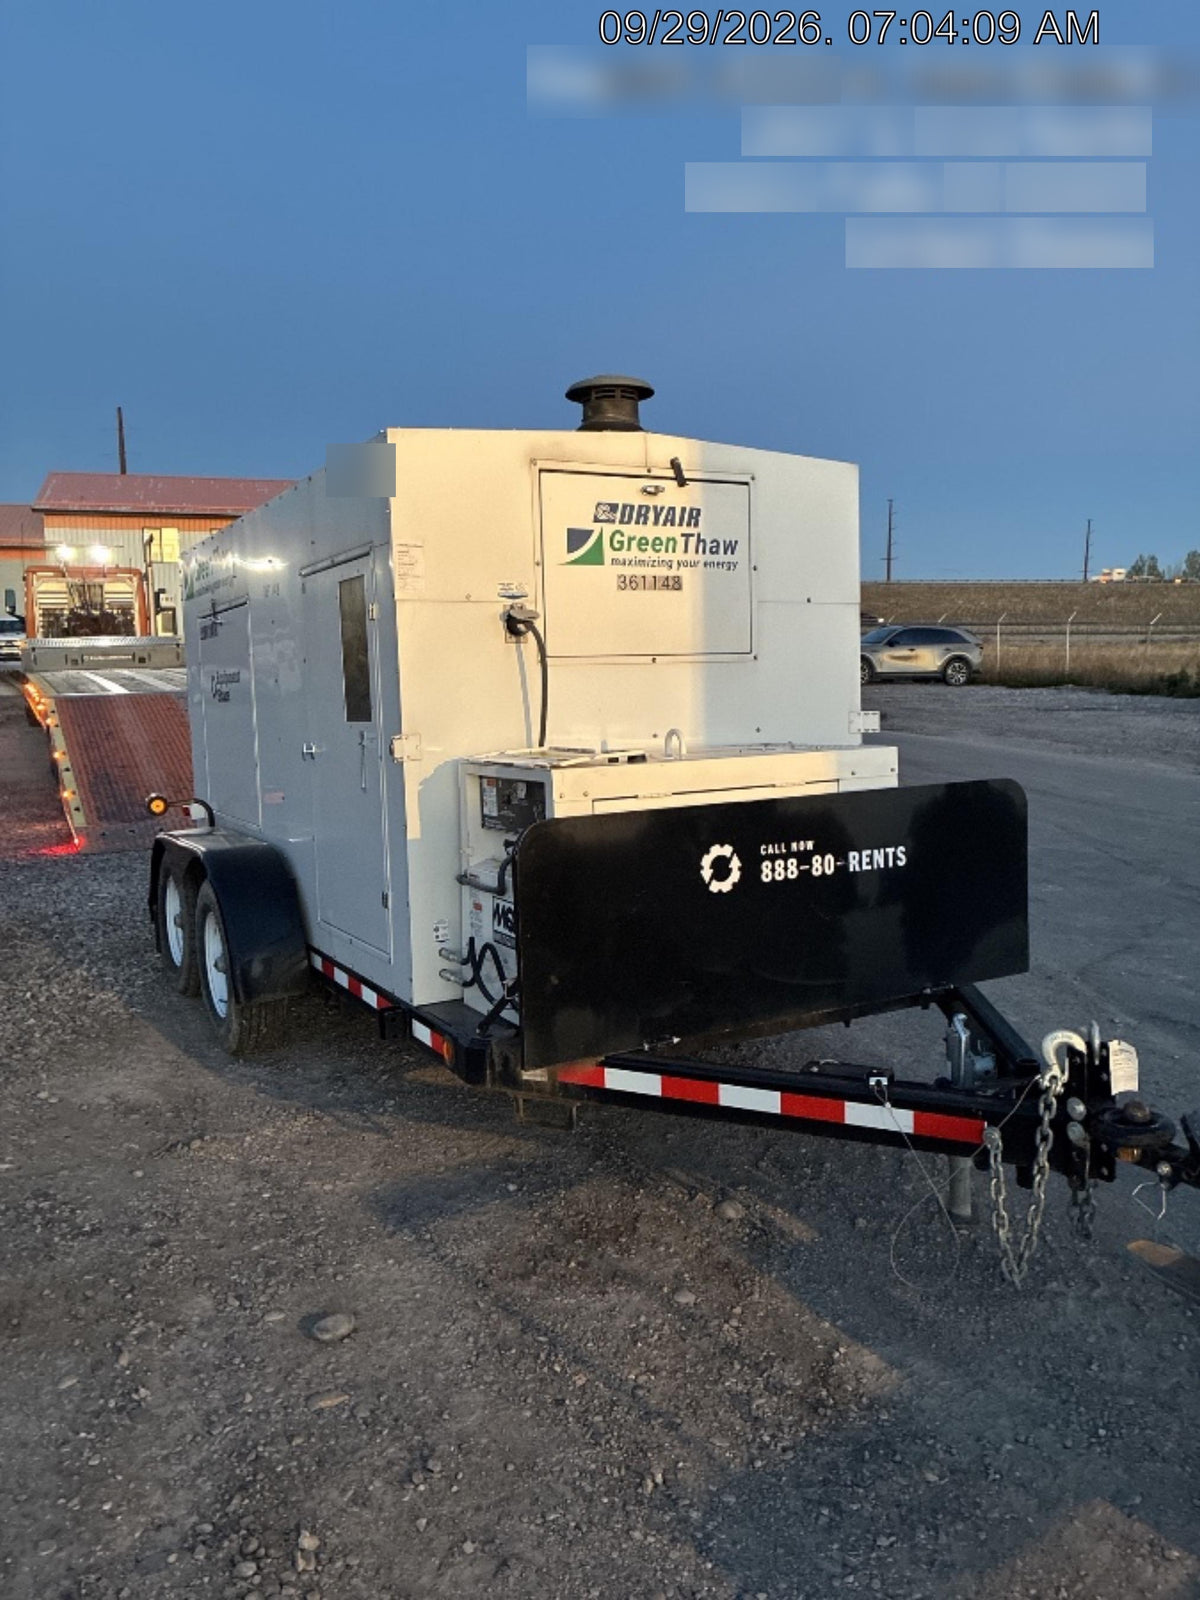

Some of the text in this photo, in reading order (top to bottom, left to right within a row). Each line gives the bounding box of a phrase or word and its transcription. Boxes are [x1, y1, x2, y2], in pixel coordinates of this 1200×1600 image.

[618, 503, 702, 529] DRYAIR
[611, 555, 739, 572] maximizing your energy
[618, 574, 682, 591] 361148
[760, 840, 815, 856] CALL NOW
